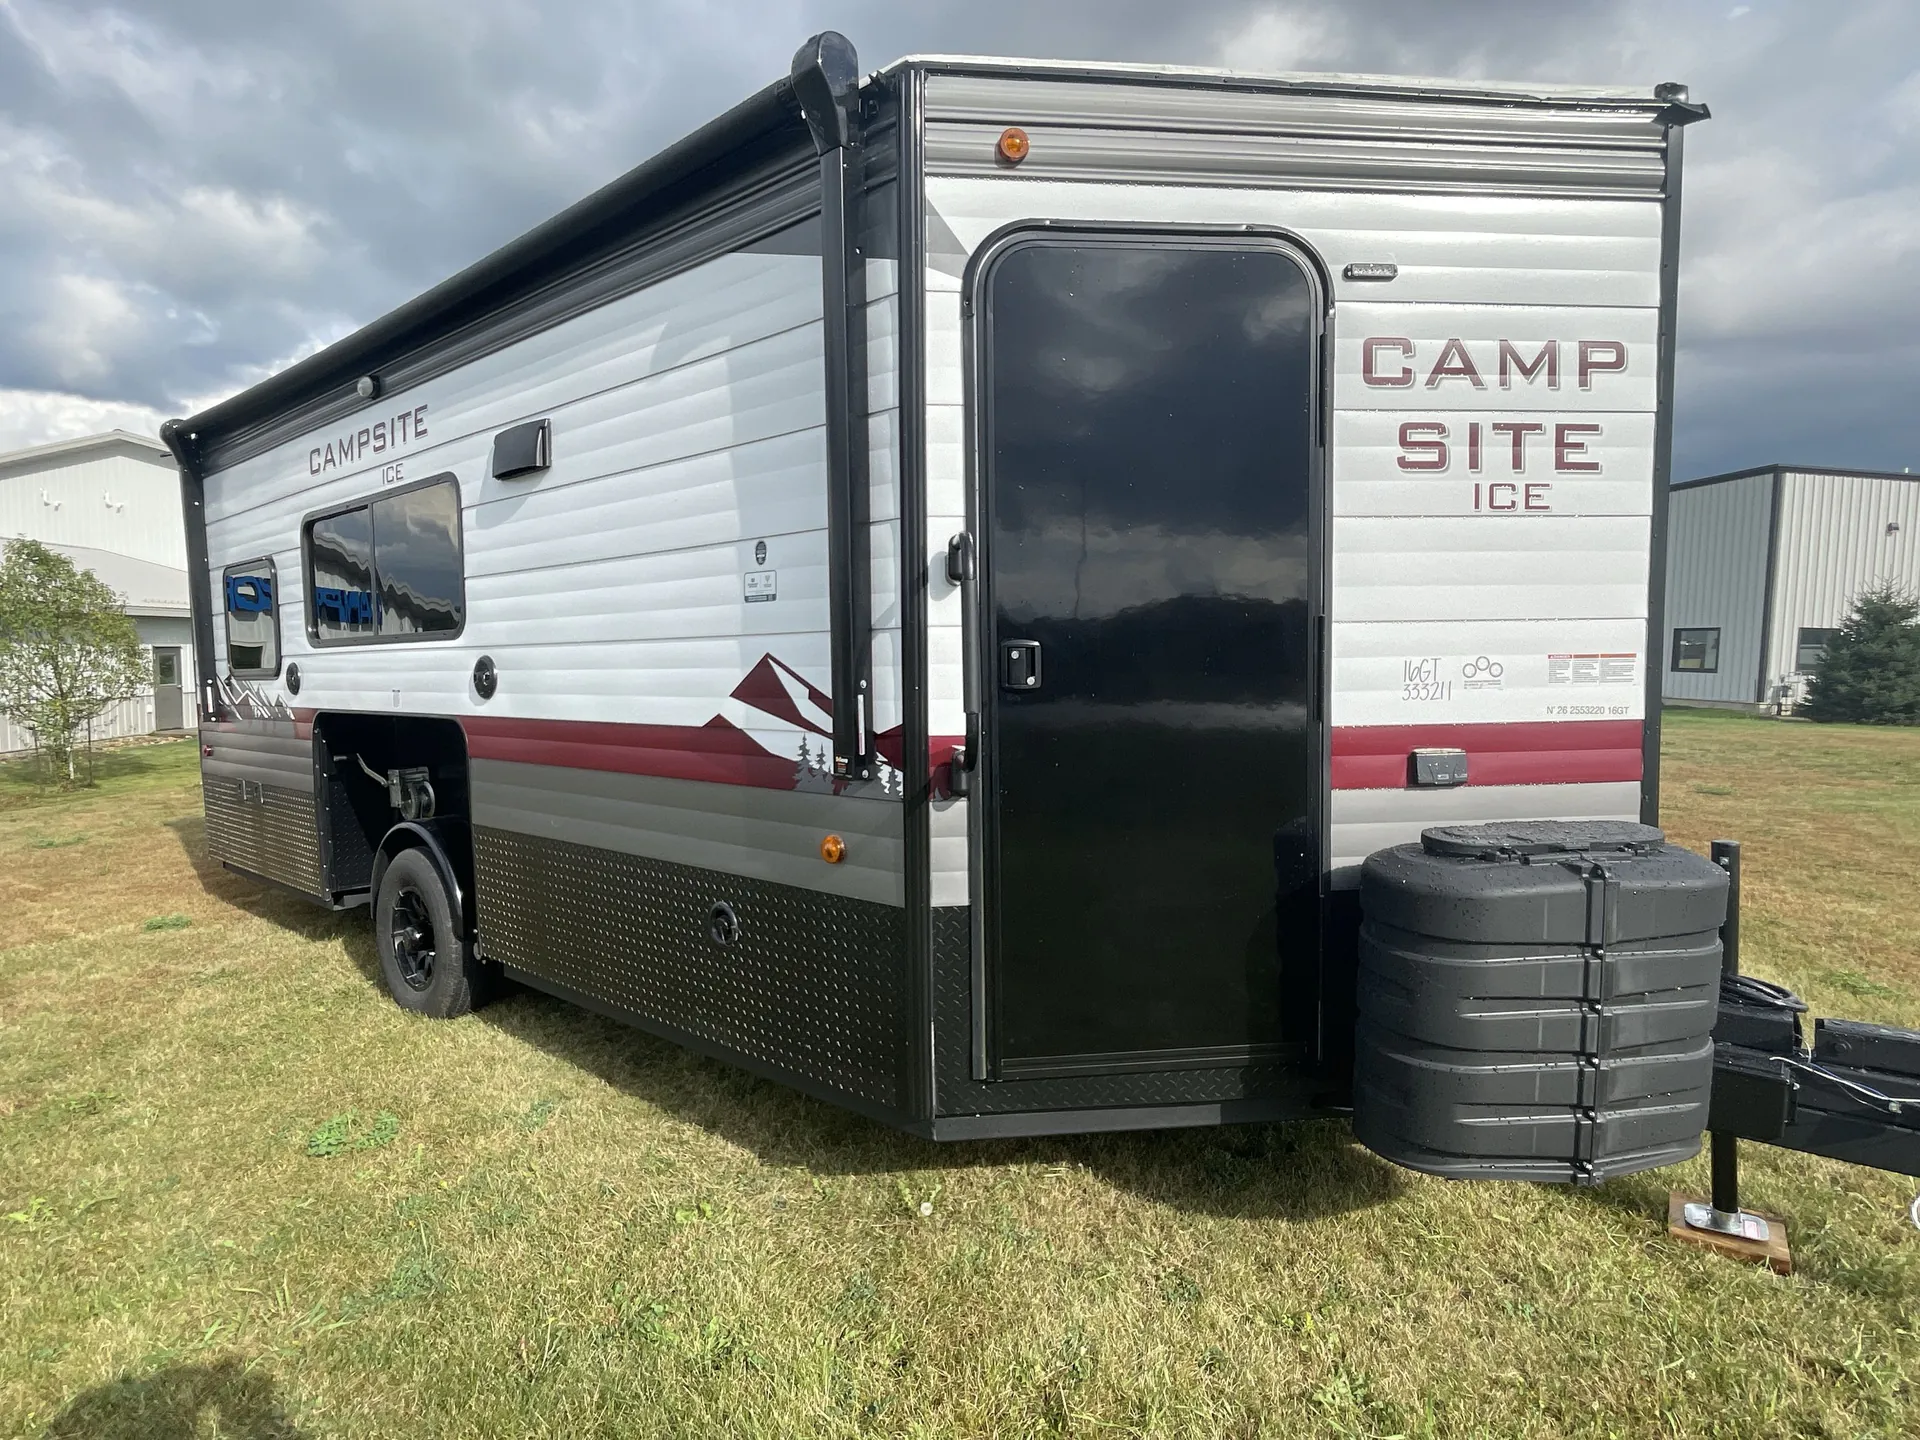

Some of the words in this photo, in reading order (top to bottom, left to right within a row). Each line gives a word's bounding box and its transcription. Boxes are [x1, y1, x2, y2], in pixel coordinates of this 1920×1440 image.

[1362, 337, 1627, 389] CAMP
[309, 404, 428, 476] CAMPSITE
[1396, 422, 1602, 473] SITE
[382, 462, 404, 485] ICE
[1474, 483, 1551, 511] ICE
[1403, 657, 1441, 683] 16GT
[1402, 680, 1452, 701] 333211
[1557, 706, 1568, 715] 26
[1607, 707, 1630, 715] 16GT
